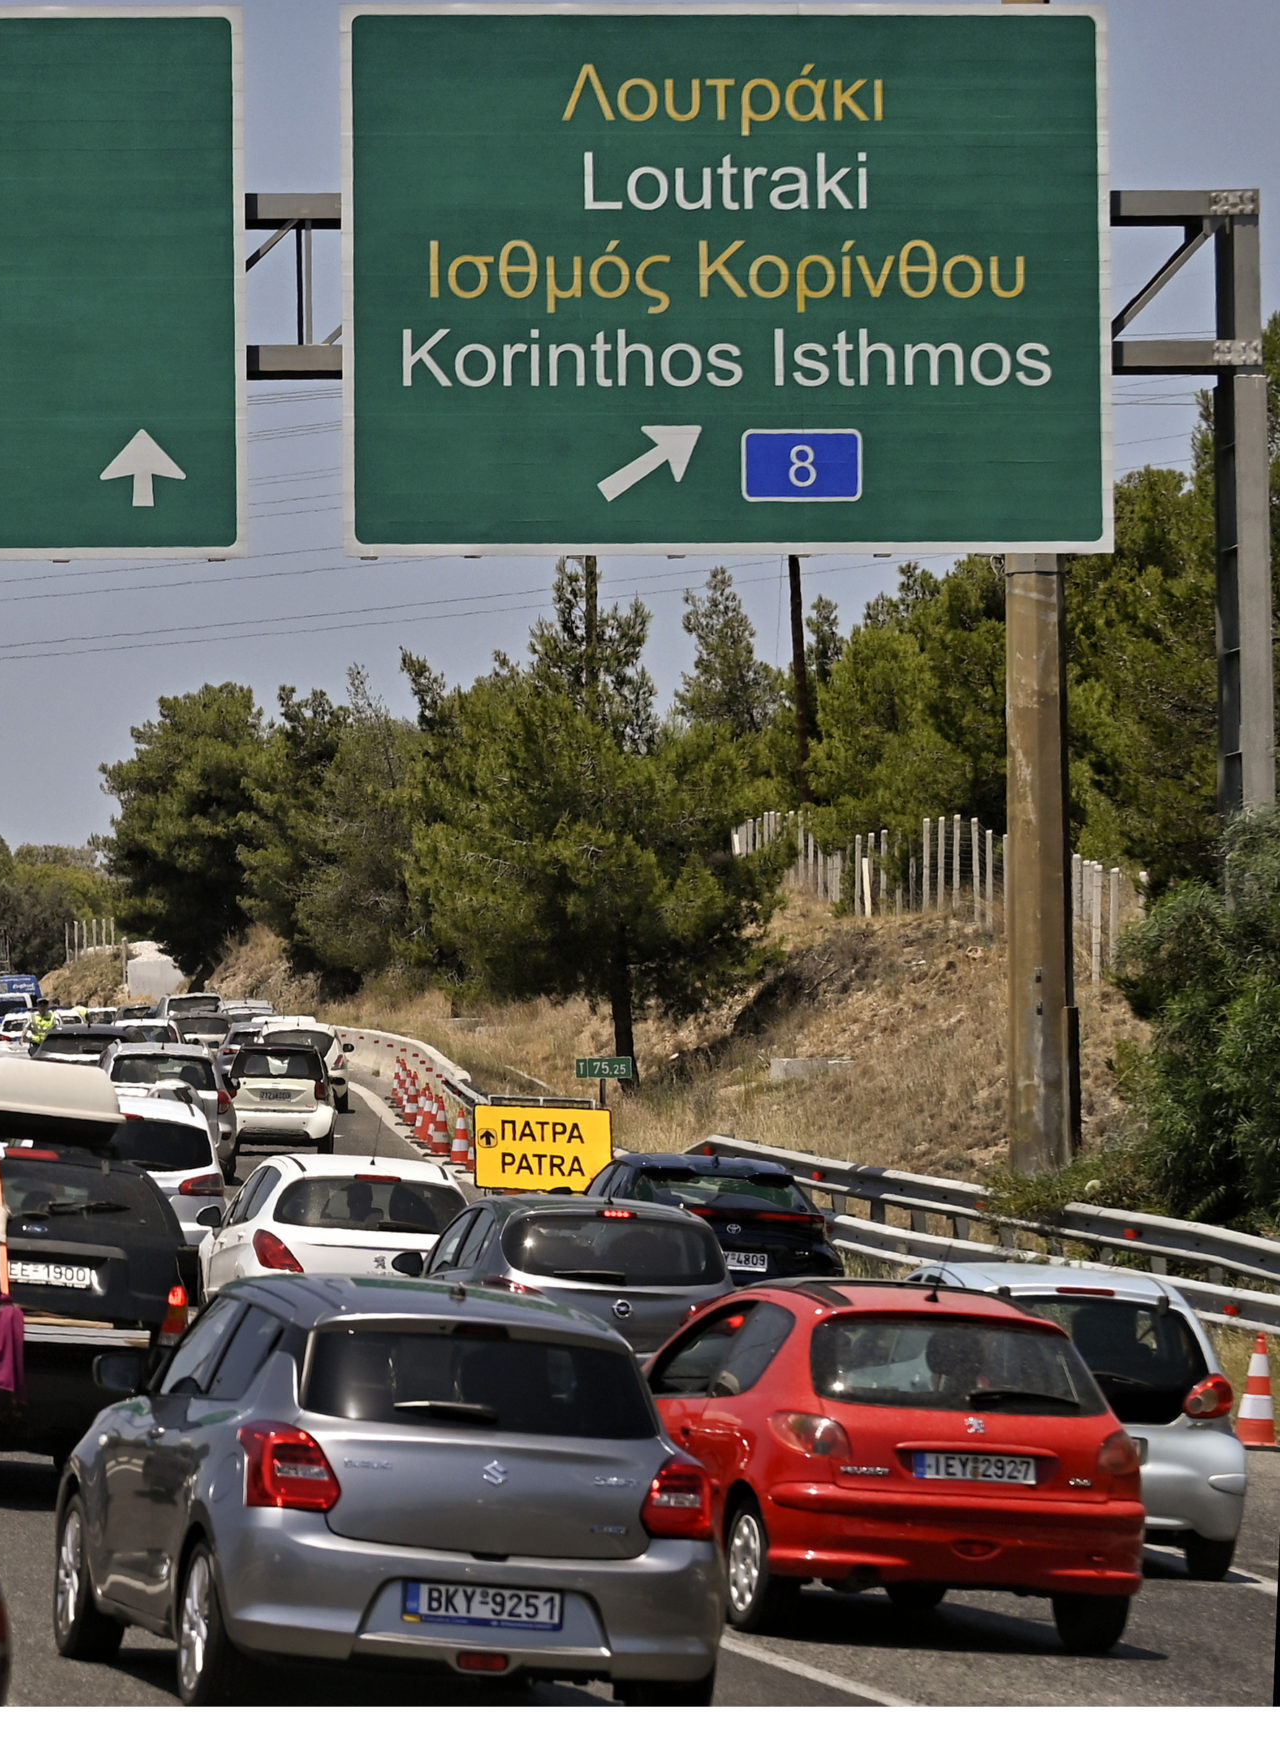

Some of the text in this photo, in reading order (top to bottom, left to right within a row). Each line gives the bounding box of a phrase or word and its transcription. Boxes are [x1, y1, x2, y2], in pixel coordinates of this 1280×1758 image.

[562, 63, 883, 137] Λουτράκι
[583, 151, 868, 211] Loutraki
[429, 239, 1025, 314] Ισθμός Κορίνθου
[402, 328, 1052, 388] Korinthos Isthmos
[788, 444, 818, 489] 8
[592, 1061, 627, 1075] 75.25
[500, 1119, 585, 1144] ΠΑΤΡΑ
[501, 1151, 586, 1177] PATRA
[8, 1261, 87, 1283] EE-1900
